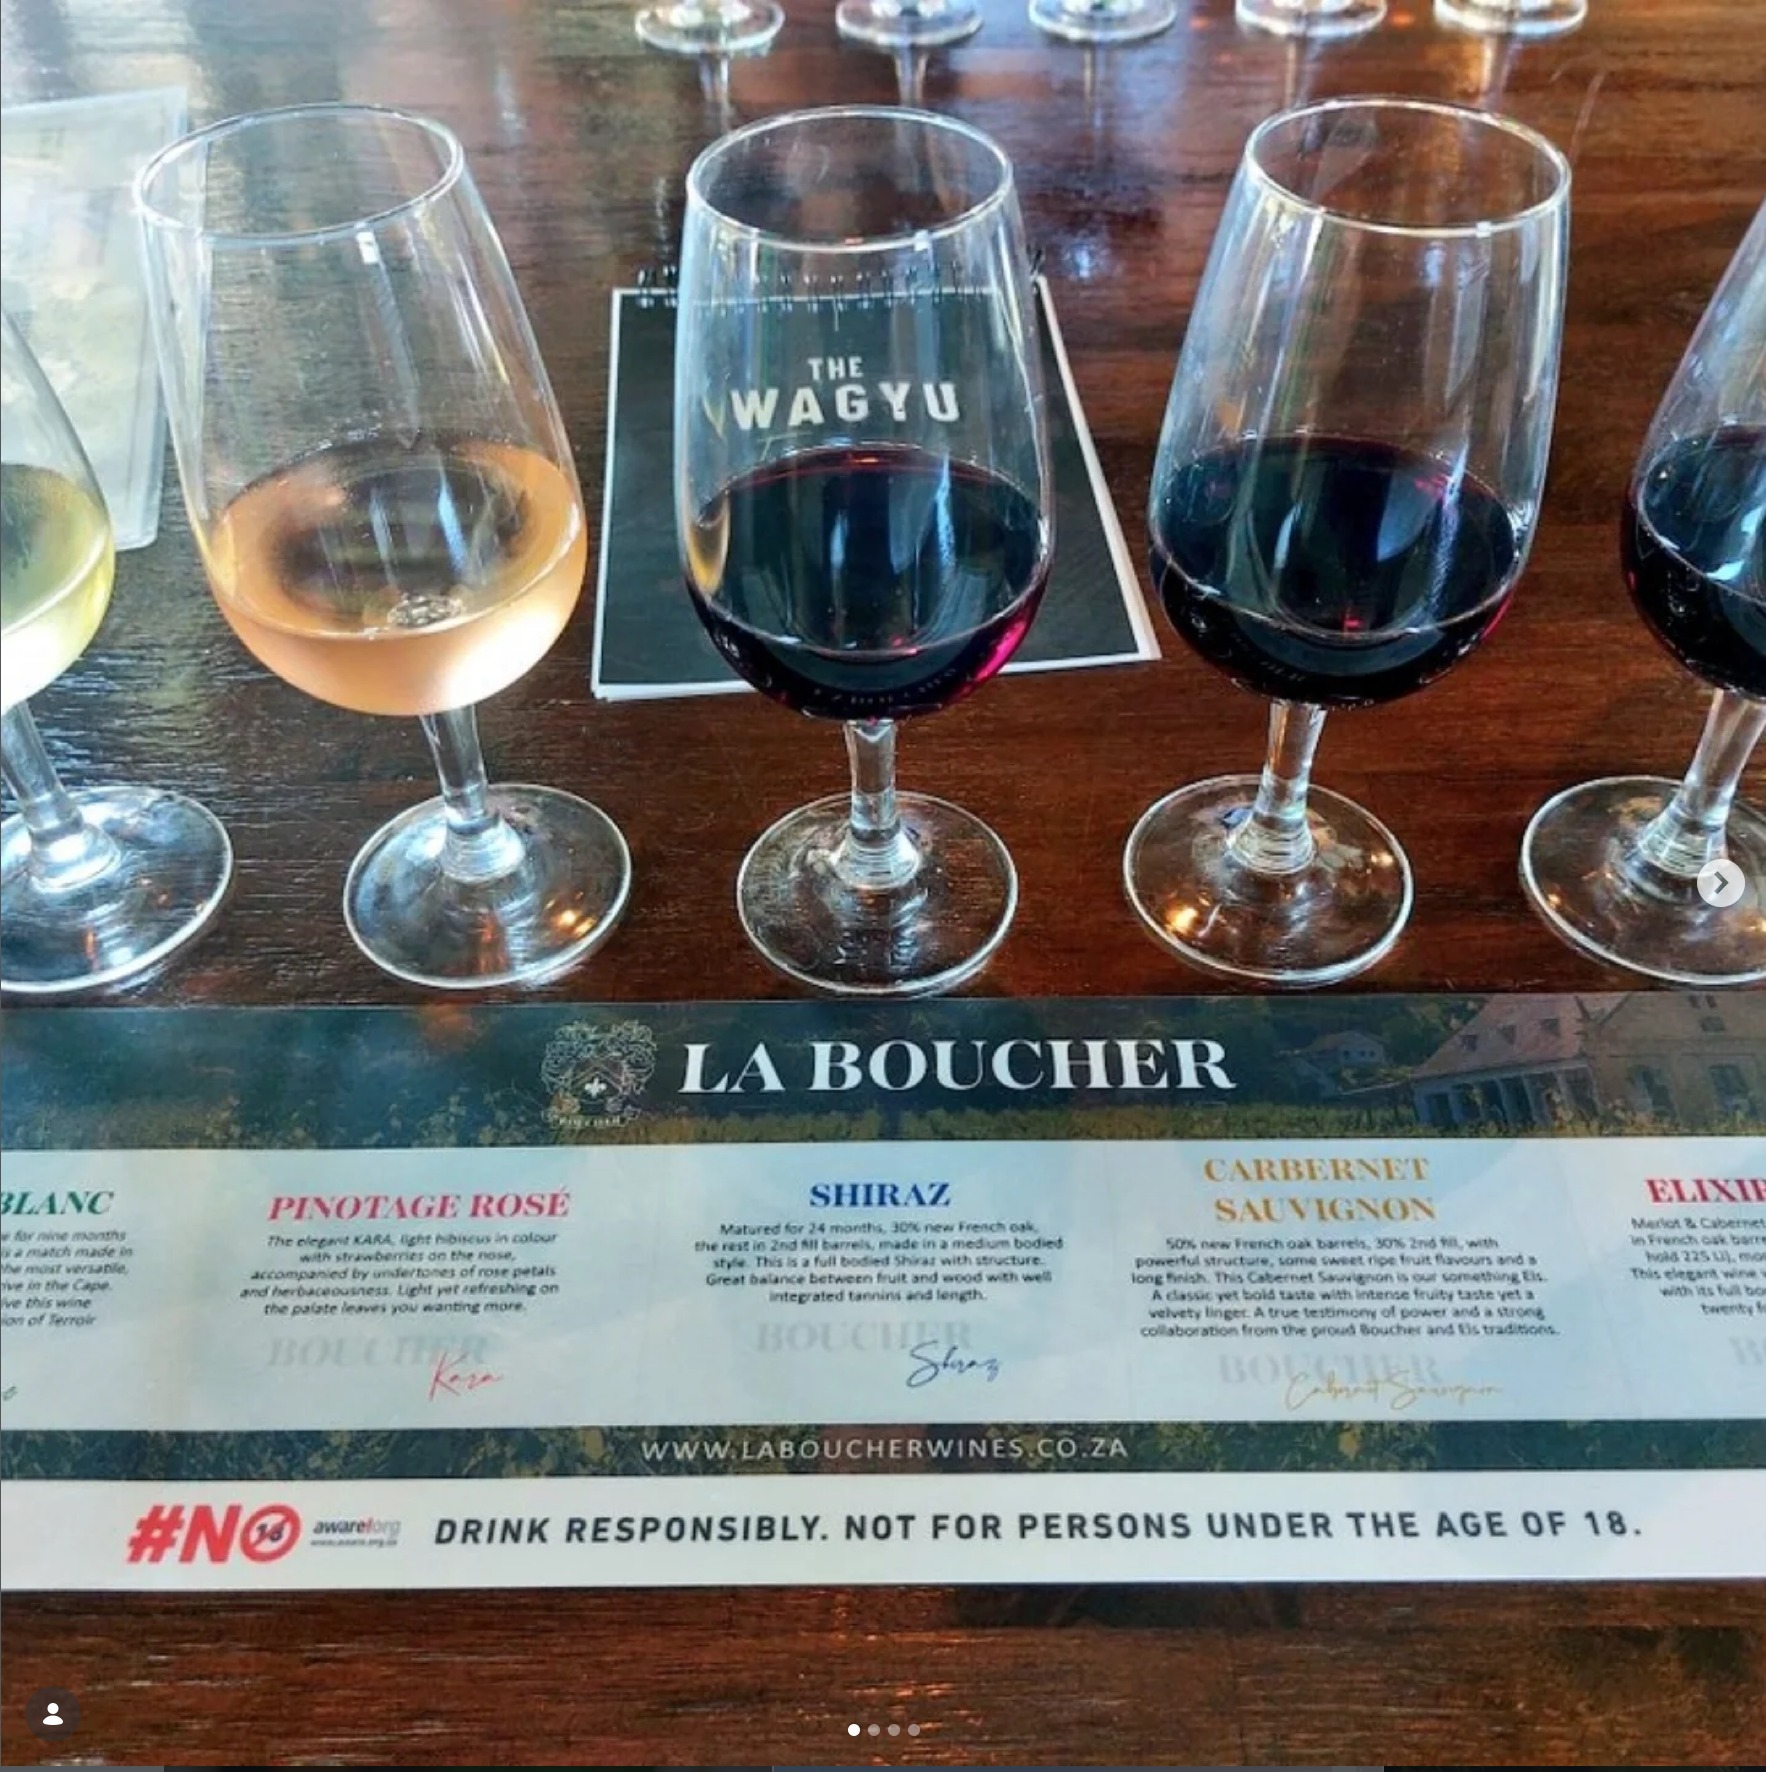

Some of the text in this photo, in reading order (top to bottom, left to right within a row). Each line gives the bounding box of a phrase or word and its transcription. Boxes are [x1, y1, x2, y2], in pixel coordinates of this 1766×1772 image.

[808, 356, 863, 381] THE
[730, 380, 960, 431] WAGYU
[679, 1039, 1236, 1094] LA BOUCHER
[1203, 1158, 1430, 1183] CARBERNET
[809, 1182, 951, 1208] SHIRAZ
[267, 1186, 570, 1221] PINOTAGE ROSÉ
[1214, 1197, 1437, 1223] SAUVIGNON
[720, 1224, 781, 1236] Matured
[784, 1224, 804, 1235] for
[808, 1224, 826, 1235] 24
[924, 1225, 954, 1234] new
[958, 1222, 1006, 1233] French
[1630, 1218, 1682, 1229] Merlot
[71, 1230, 126, 1241] months
[266, 1235, 293, 1246] The
[297, 1234, 349, 1249] elegant
[400, 1233, 432, 1247] light
[435, 1232, 492, 1244] hibiscus
[512, 1232, 558, 1244] colour
[1647, 1234, 1698, 1246] French
[694, 1240, 719, 1251] the
[722, 1240, 749, 1251] rest
[770, 1240, 798, 1251] 2nd
[878, 1239, 918, 1250] made
[952, 1238, 1010, 1249] medium
[1014, 1237, 1064, 1249] bodied
[1200, 1240, 1232, 1249] new
[1235, 1238, 1284, 1249] French
[1286, 1238, 1311, 1249] oak
[1410, 1237, 1437, 1248] 2nd
[1466, 1237, 1498, 1248] with
[26, 1246, 116, 1258] match made
[300, 1250, 517, 1262] with strawberries the nose,
[25, 1262, 62, 1274] most
[756, 1256, 783, 1267] This
[814, 1256, 836, 1267] full
[840, 1255, 890, 1267] bodied
[894, 1255, 935, 1266] Shiraz
[940, 1255, 972, 1266] with
[1134, 1255, 1200, 1269] powerful
[1278, 1257, 1316, 1266] some
[1321, 1255, 1364, 1266] sweet
[1368, 1255, 1396, 1268] ripe
[1400, 1255, 1432, 1266] fruit
[1434, 1255, 1492, 1265] flavours
[1496, 1254, 1524, 1265] and
[250, 1265, 556, 1282] accompanied undertones rose petals
[706, 1271, 1052, 1284] Great balance between fruit and wood with well
[1131, 1273, 1164, 1286] long
[1214, 1272, 1243, 1283] This
[1246, 1272, 1314, 1283] Cabernet
[1318, 1272, 1394, 1285] Sauvignon
[1412, 1274, 1437, 1282] our
[1442, 1271, 1521, 1285] something
[1664, 1268, 1719, 1282] elegant
[240, 1286, 270, 1298] and
[398, 1284, 432, 1298] Light
[436, 1284, 460, 1298] yet
[462, 1283, 537, 1297] refreshing
[769, 1290, 844, 1304] integrated
[848, 1290, 900, 1301] tannins
[906, 1290, 933, 1301] and
[1166, 1289, 1521, 1303] classic yet bold taste with intense fruity taste yet
[56, 1297, 92, 1308] wine
[264, 1303, 288, 1314] the
[291, 1303, 338, 1316] palate
[341, 1302, 386, 1313] leaves
[391, 1304, 418, 1315] you
[422, 1301, 480, 1314] wanting
[1149, 1307, 1201, 1320] velvety
[1268, 1307, 1299, 1318] true
[1304, 1306, 1376, 1320] testimony
[1400, 1309, 1446, 1320] power
[1452, 1306, 1480, 1317] and
[1497, 1306, 1545, 1320] strong
[1140, 1325, 1238, 1337] collaboration
[1242, 1325, 1278, 1337] from
[1282, 1325, 1306, 1337] the
[1311, 1325, 1356, 1339] proud
[1360, 1325, 1421, 1336] Boucher
[1426, 1325, 1454, 1336] and
[641, 1437, 1129, 1461] WWW.LABOUCHERWINES.CO.ZA
[434, 1510, 1641, 1545] DRINK RESPONSIBLY. NOT FOR PERSONS UNDER THE AGE OF 18.
